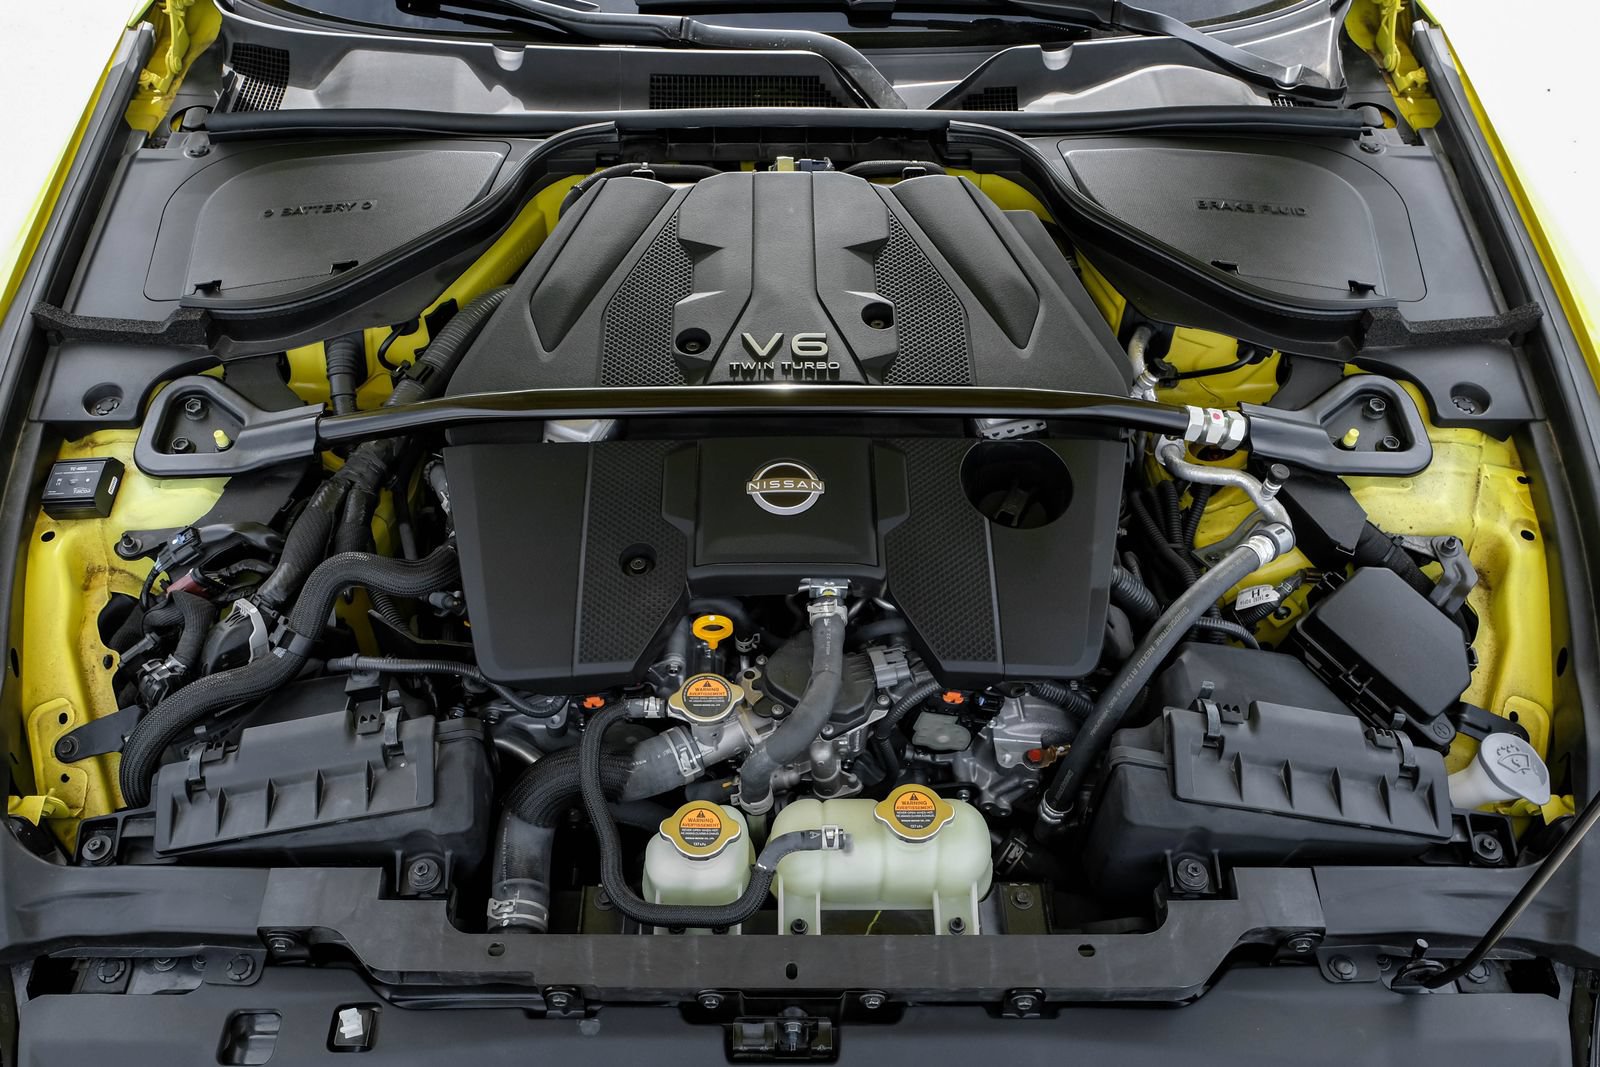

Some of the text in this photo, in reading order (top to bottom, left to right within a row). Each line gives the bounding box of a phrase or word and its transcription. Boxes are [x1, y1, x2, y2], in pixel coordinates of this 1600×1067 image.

[281, 202, 357, 217] BATTERY
[1198, 200, 1306, 217] BRAKE FLUID
[742, 332, 828, 356] V6
[729, 361, 840, 370] TWIN TURBO
[748, 480, 822, 490] NISSAN
